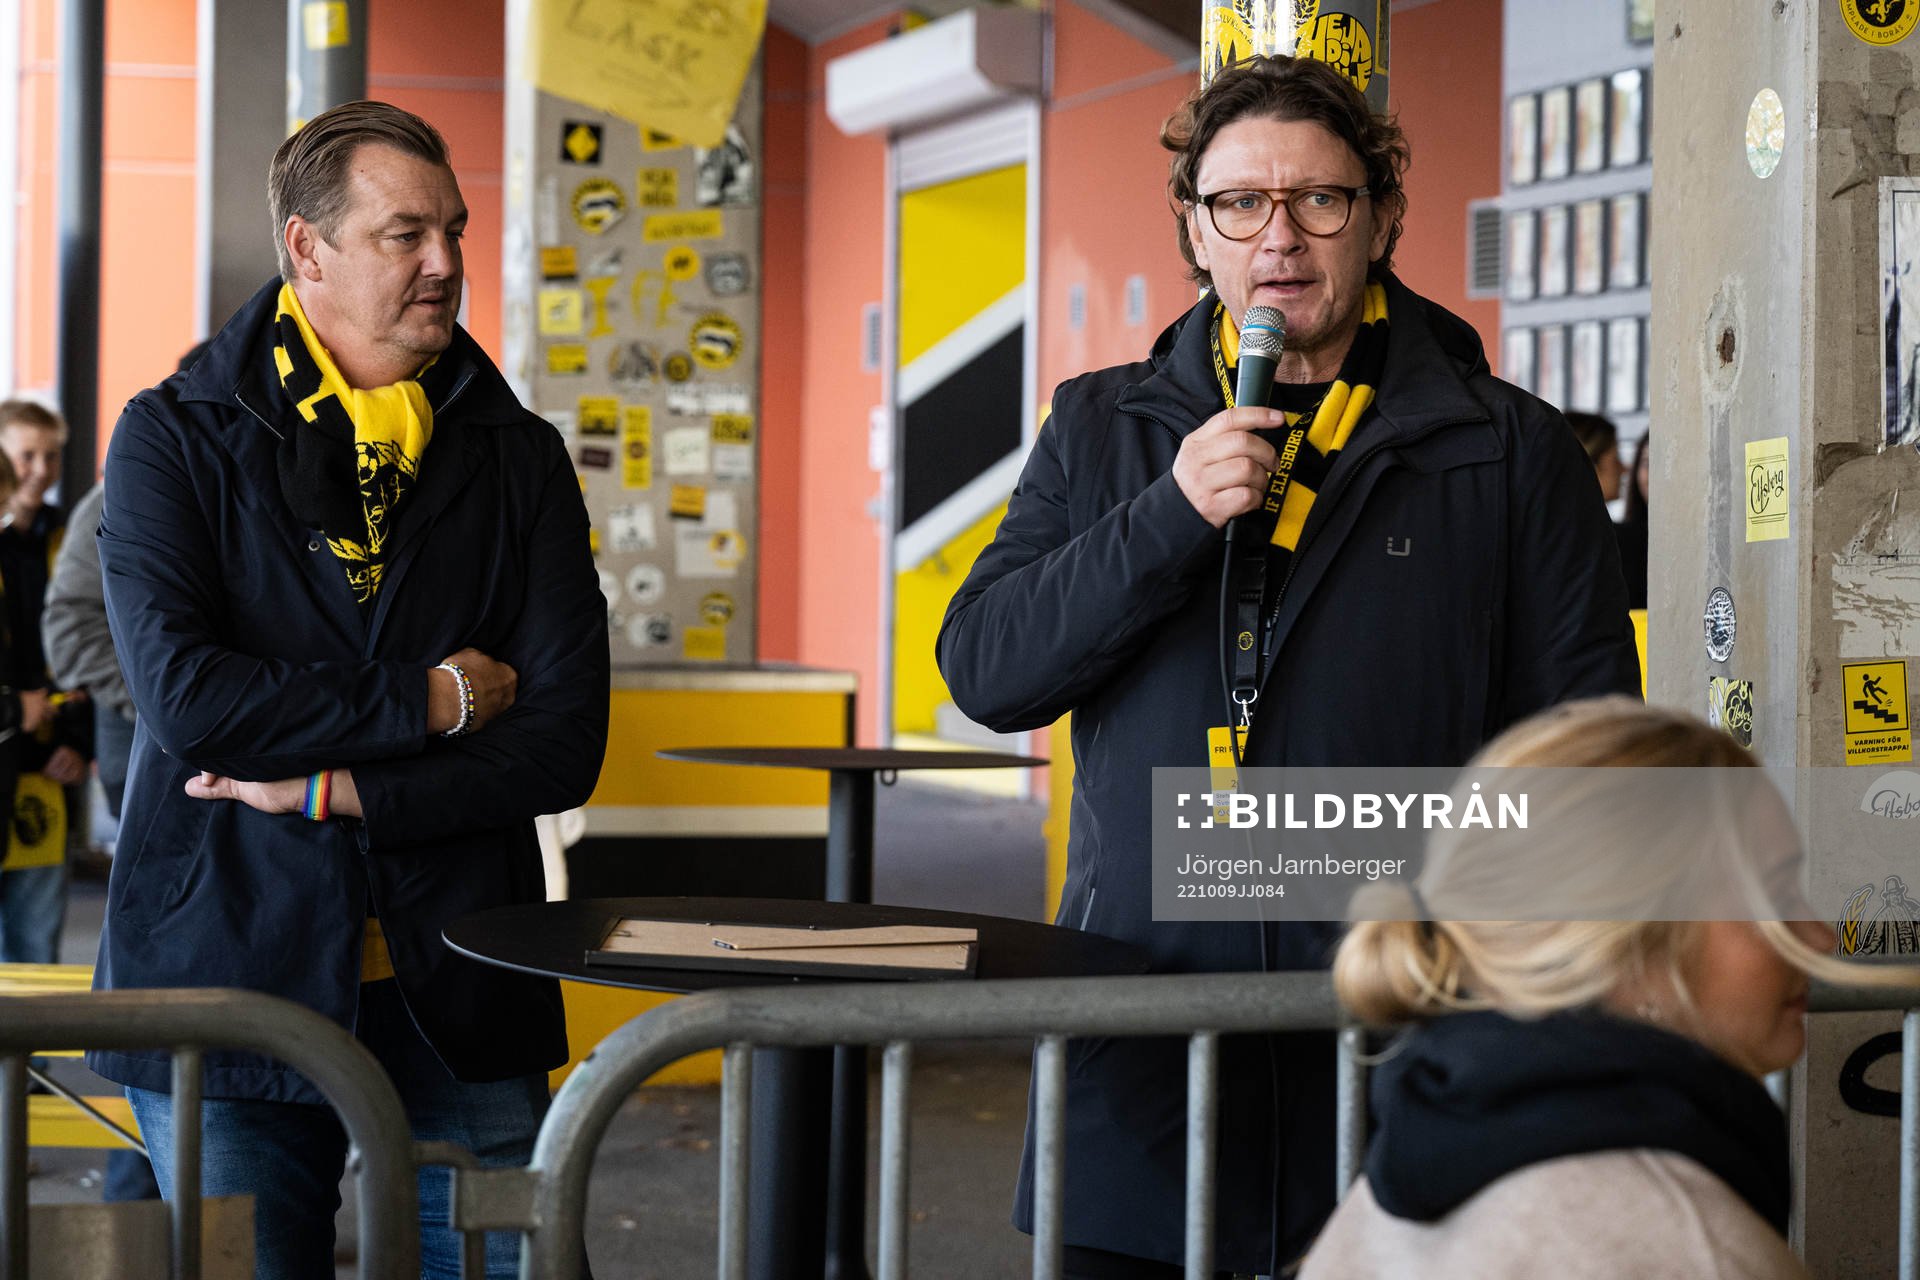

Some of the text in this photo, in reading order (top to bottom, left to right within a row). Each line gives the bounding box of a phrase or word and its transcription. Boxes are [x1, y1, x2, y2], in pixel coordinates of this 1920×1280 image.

[1216, 353, 1236, 409] ELFSBOR
[1264, 428, 1305, 513] IF ELFSBORG
[1847, 744, 1909, 755] VILLKORSTRAPPA!
[1854, 735, 1902, 746] VARNING FÖR
